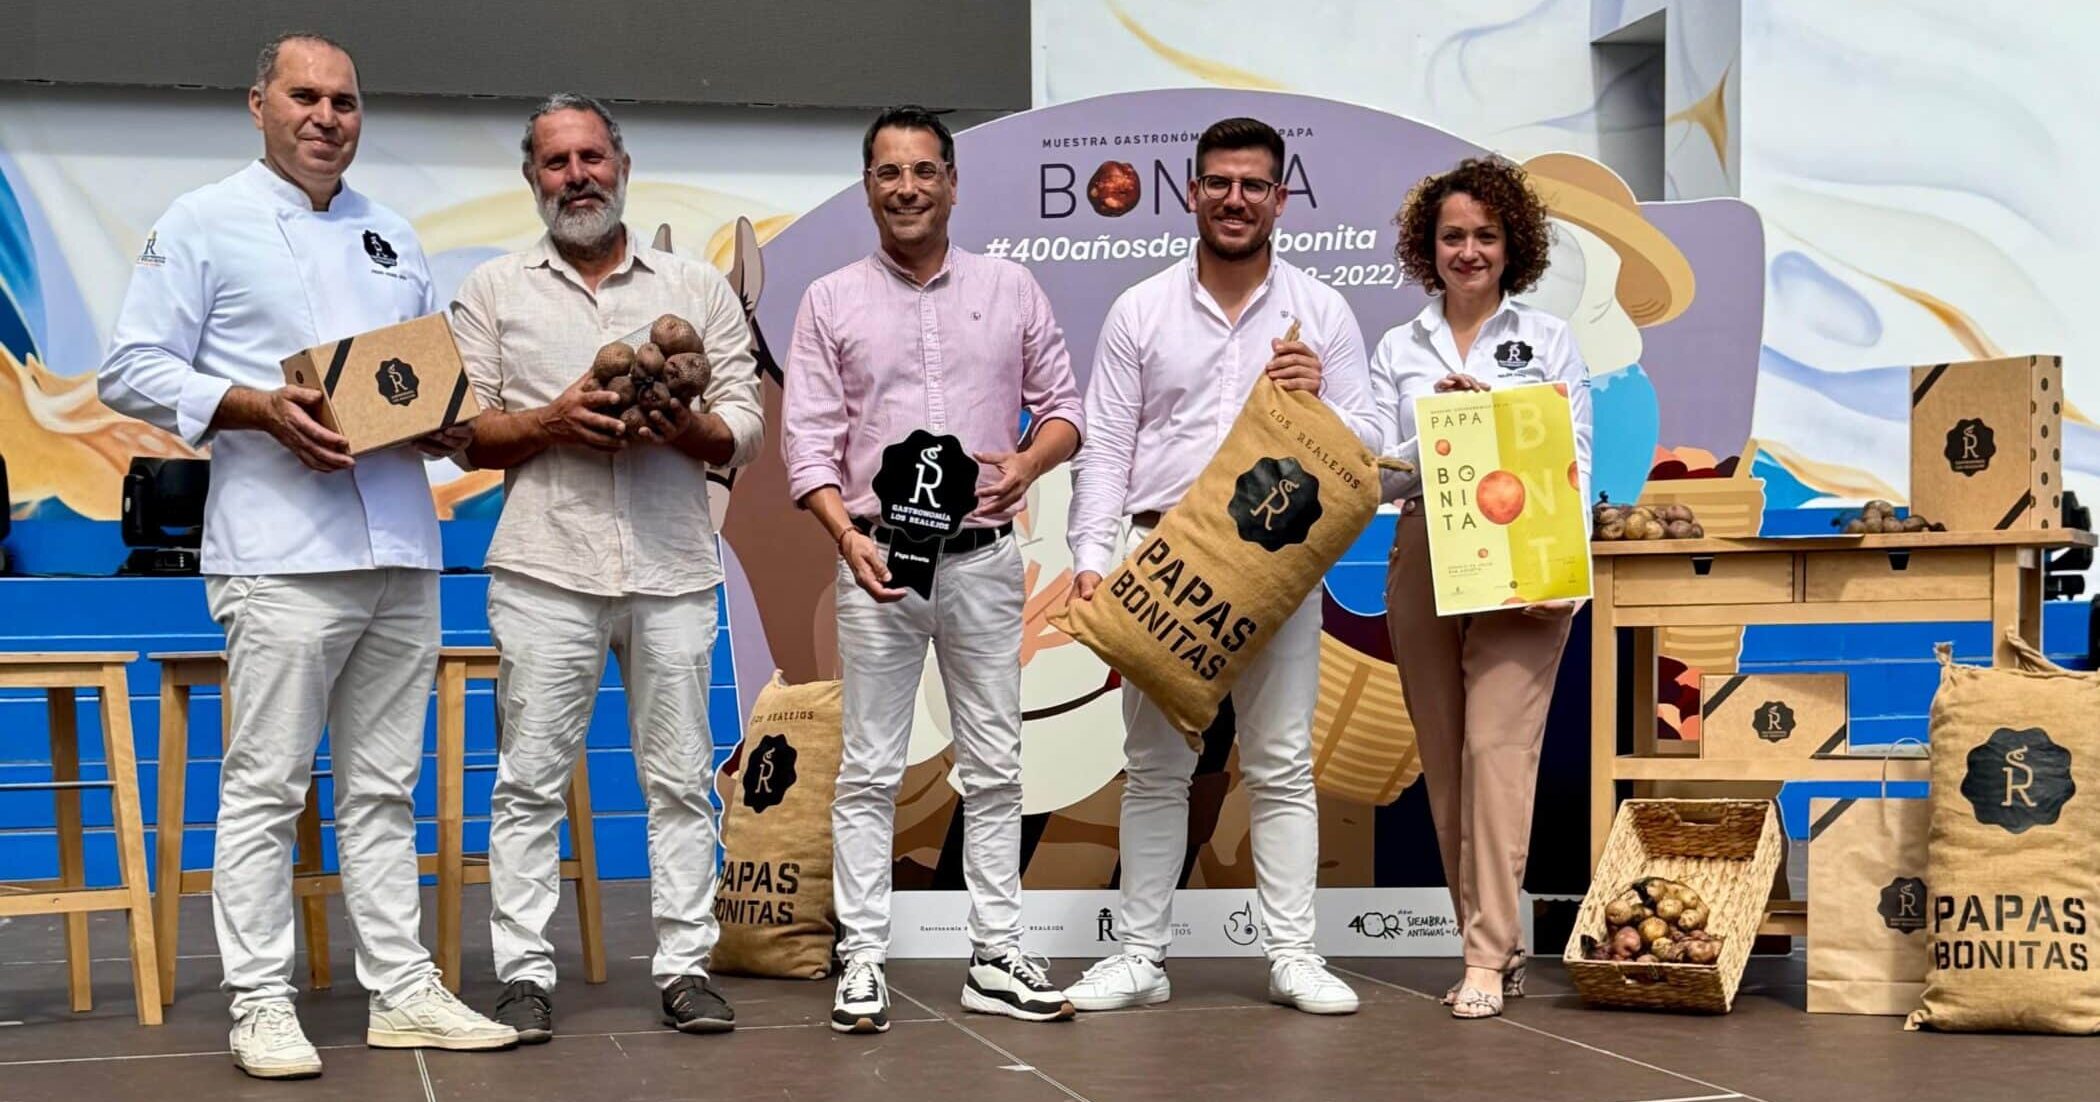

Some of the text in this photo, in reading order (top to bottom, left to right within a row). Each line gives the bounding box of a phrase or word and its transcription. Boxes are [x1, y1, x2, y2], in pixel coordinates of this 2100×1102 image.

[1042, 137, 1108, 148] MUESTRA
[1114, 130, 1200, 146] GASTRONÓM
[1431, 411, 1482, 429] PAPA
[1269, 409, 1361, 490] LOS REALEJOS
[890, 512, 950, 530] LOS REALEJOS
[891, 503, 952, 522] GASTRONOMÍA
[1135, 537, 1257, 653] PAPAS
[1110, 569, 1227, 681] BONITAS
[766, 710, 815, 722] REALEJOS
[1407, 916, 1447, 926] SIEMBRA
[1934, 894, 2087, 936] PAPAS
[1407, 928, 1445, 937] ANTIGUAS
[1934, 940, 2089, 972] BONITAS
